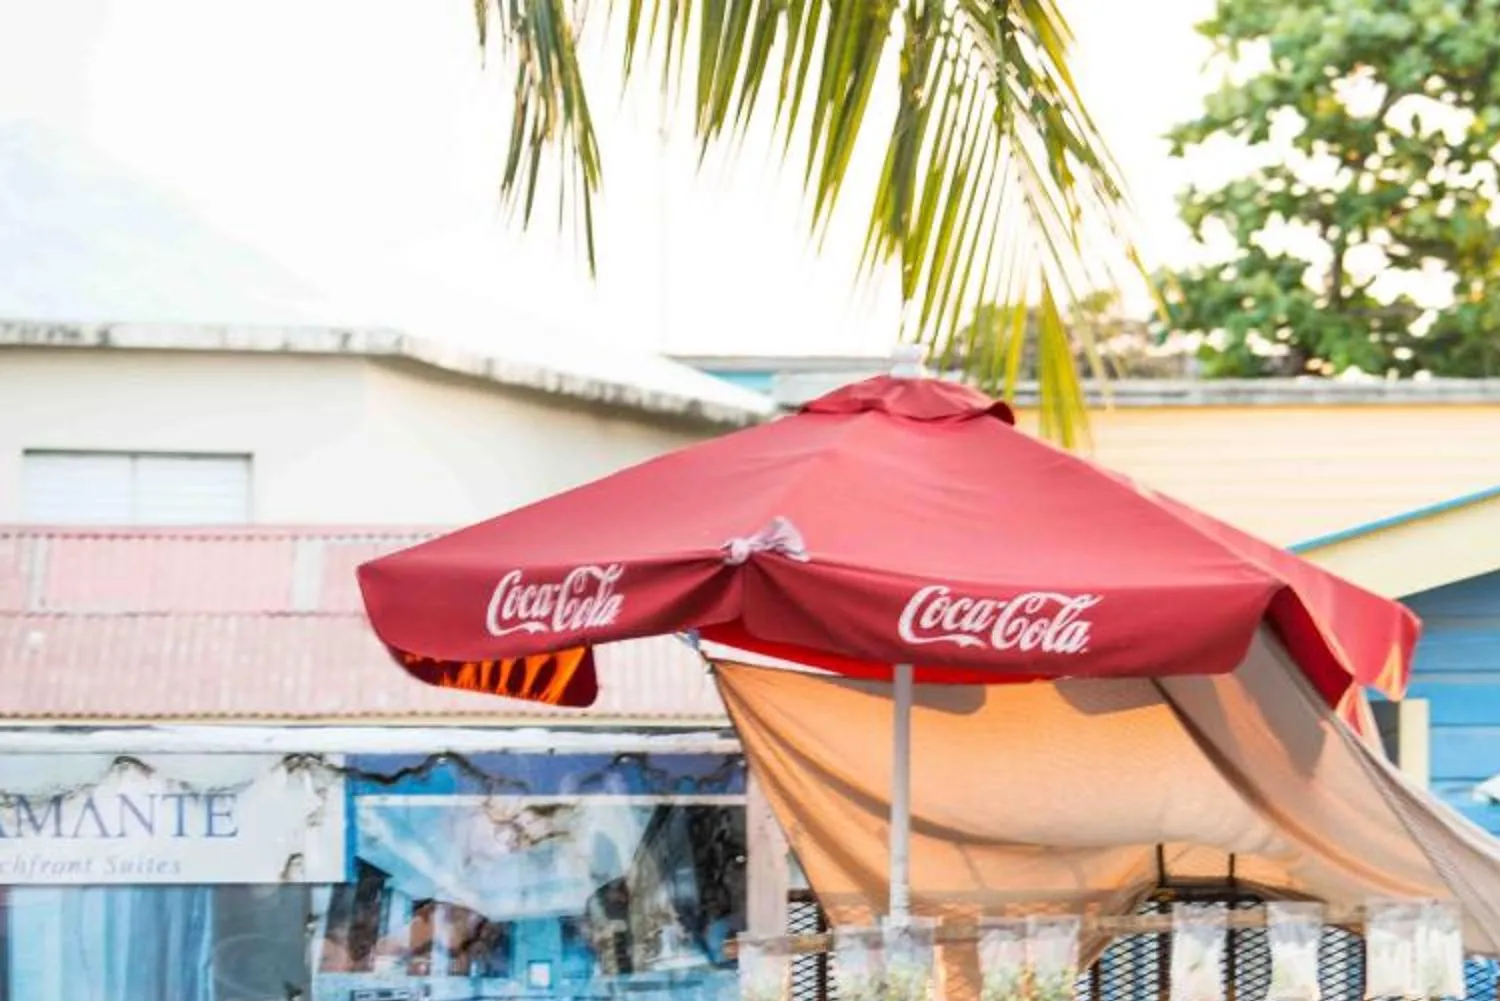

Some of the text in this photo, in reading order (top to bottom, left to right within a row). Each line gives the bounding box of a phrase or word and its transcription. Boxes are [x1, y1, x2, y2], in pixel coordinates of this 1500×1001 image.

[898, 585, 1104, 653] Coca-Cola
[0, 793, 239, 838] MANTE
[103, 854, 182, 876] Suites
